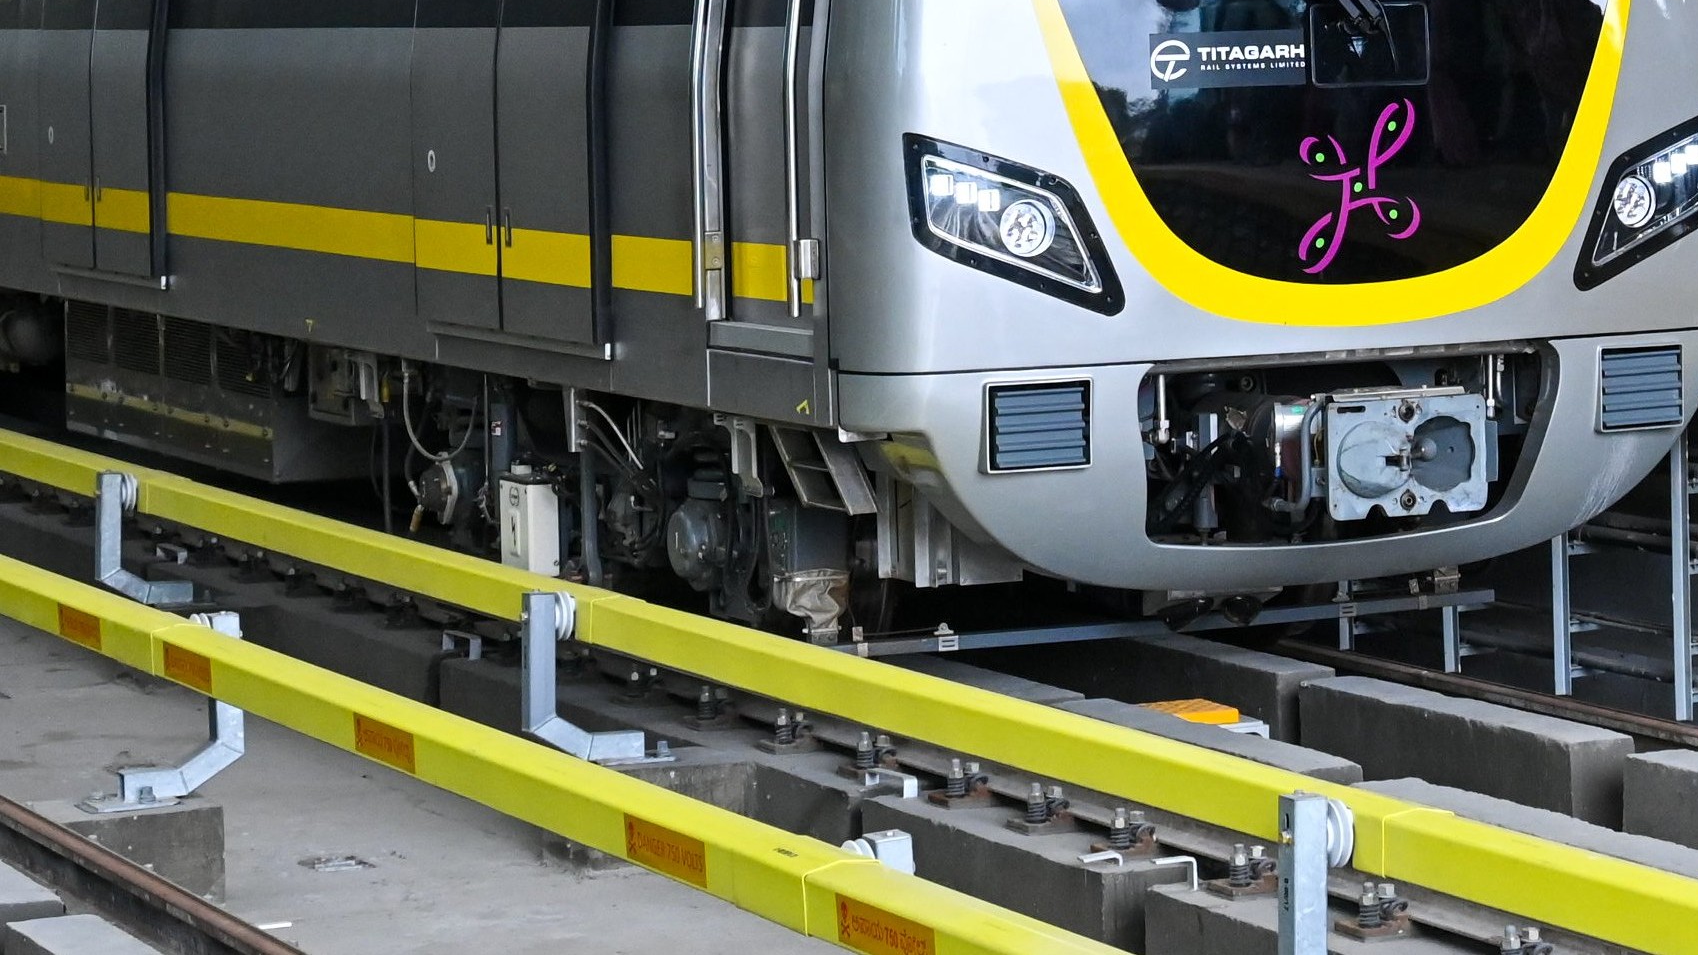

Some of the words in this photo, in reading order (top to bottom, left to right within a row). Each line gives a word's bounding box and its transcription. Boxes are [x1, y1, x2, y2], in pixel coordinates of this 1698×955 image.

[1197, 44, 1305, 62] TITAGARH
[1200, 63, 1221, 71] RAIL
[1225, 62, 1266, 70] SYSTEMS
[1270, 61, 1306, 69] LIMITED
